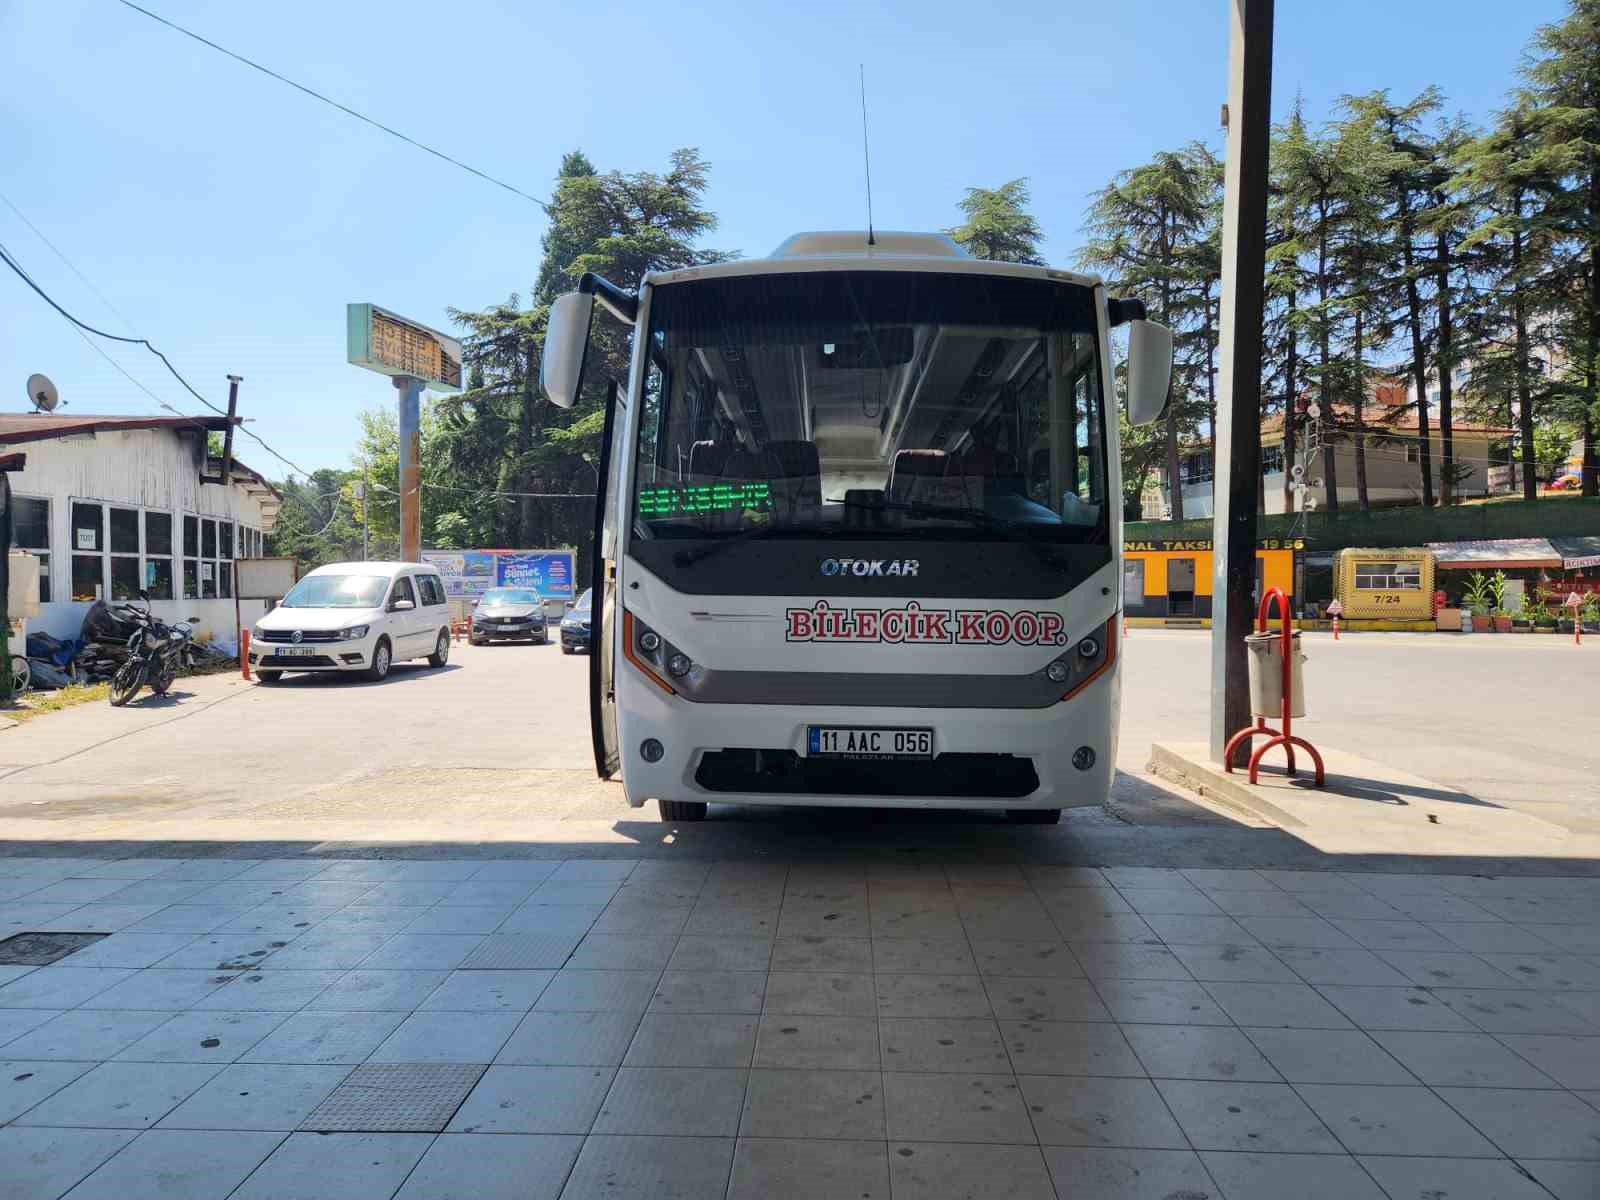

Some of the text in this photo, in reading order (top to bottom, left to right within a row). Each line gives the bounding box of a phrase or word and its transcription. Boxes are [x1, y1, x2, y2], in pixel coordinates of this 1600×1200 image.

[820, 558, 920, 577] OTOKAR
[1374, 594, 1401, 604] 7/24
[786, 600, 1068, 646] BİLECİK KOOP.
[822, 731, 929, 752] 11 AAC 056
